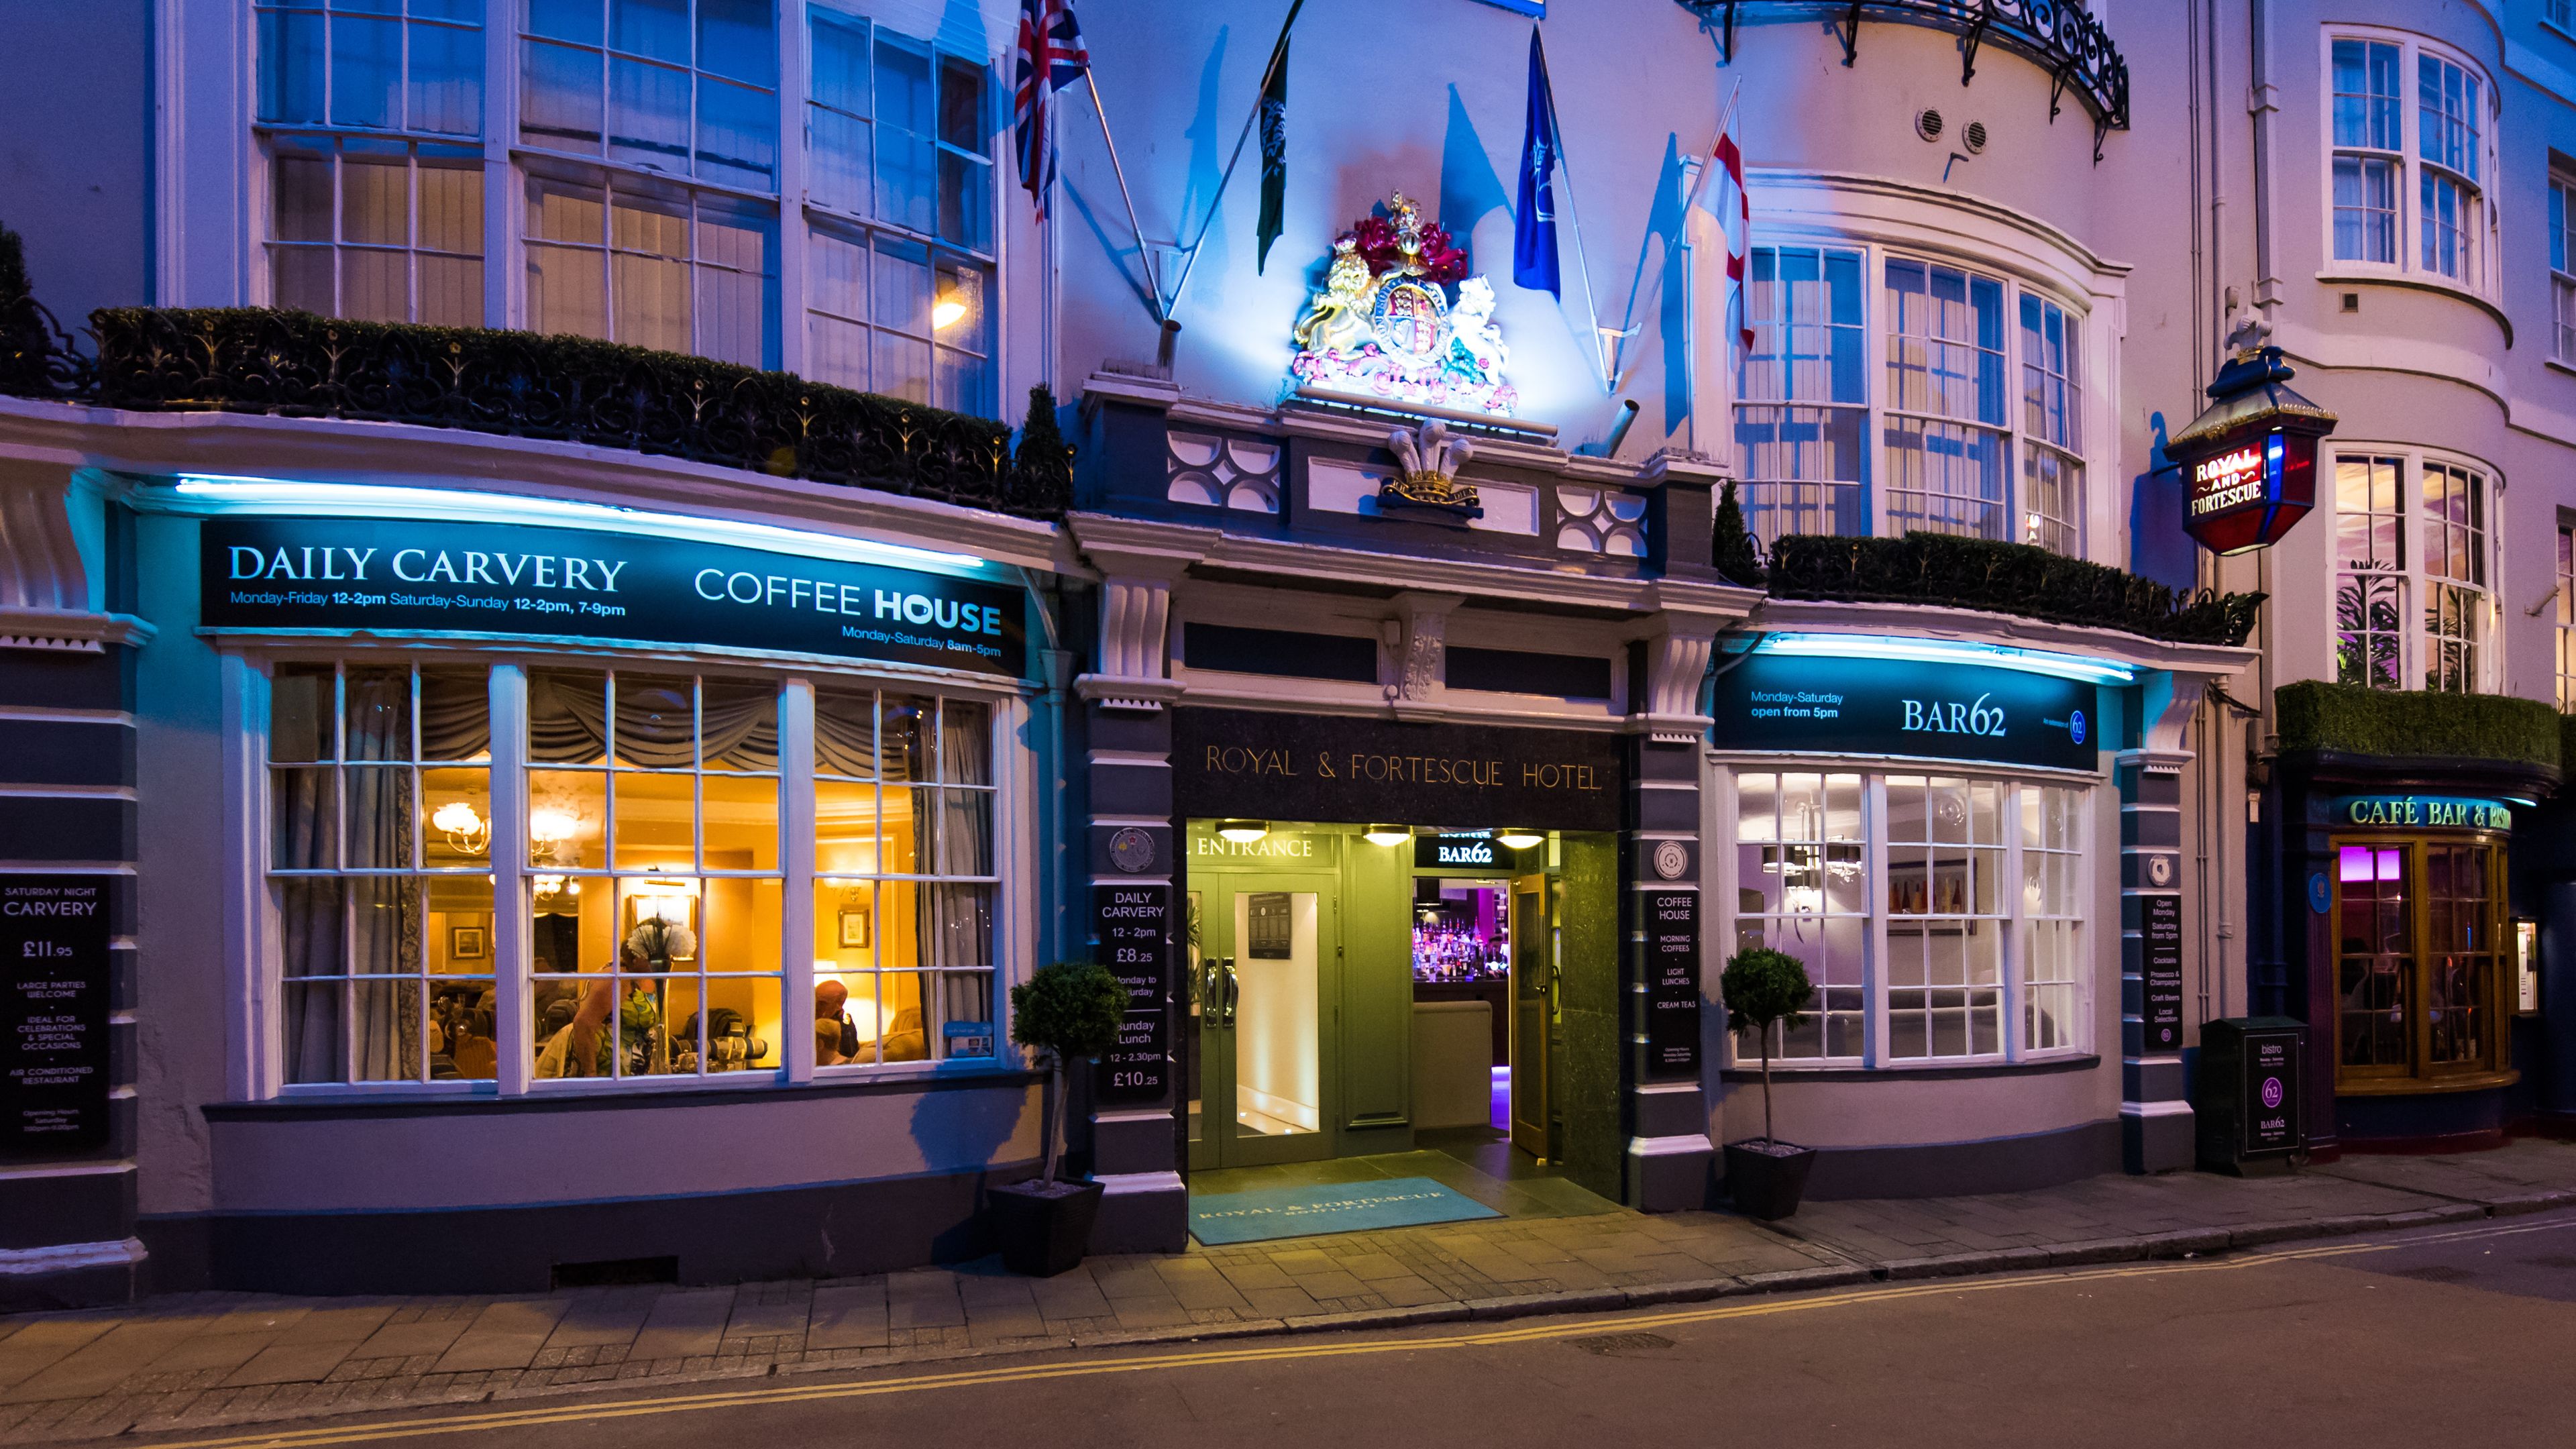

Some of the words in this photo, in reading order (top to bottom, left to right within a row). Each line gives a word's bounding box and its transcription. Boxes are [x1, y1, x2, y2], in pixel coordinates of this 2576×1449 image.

[2196, 449, 2258, 482] ROYAL
[2210, 474, 2240, 491] AND
[2191, 480, 2261, 517] FORTESCUE
[227, 545, 378, 580] DAILY
[392, 549, 627, 592] CARVERY
[231, 591, 328, 607] Monday-Friday
[332, 592, 386, 608] 12-2pm
[390, 593, 509, 611] Saturday-Sunday
[513, 598, 574, 615] 12-2pm,
[578, 601, 626, 616] 7-9pm
[694, 568, 861, 616] COFFEE
[874, 589, 1002, 636] HOUSE
[842, 625, 945, 651] Monday-Saturday
[947, 639, 1002, 658] 8am-5pm
[1752, 690, 1843, 706] Monday-Saturday
[1752, 707, 1781, 719] open
[1783, 706, 1811, 718] from
[1813, 707, 1838, 720] 5pm
[1901, 692, 2007, 737] BAR62
[1208, 745, 1299, 776] ROYAL
[1318, 751, 1336, 778] &
[1351, 754, 1503, 787] FORTESCUE
[1523, 763, 1602, 790] HOTEL
[2349, 796, 2419, 824] CAFÉ
[2428, 802, 2468, 826] BAR
[2474, 804, 2485, 826] &
[1197, 837, 1312, 857] ENTRANCE
[1438, 841, 1493, 863] BAR62
[5, 888, 60, 897] SATURDAY
[64, 888, 97, 897] NIGHT
[1115, 893, 1152, 904] DAILY
[1657, 898, 1692, 907] COFFEE
[2156, 900, 2172, 908] Open
[3, 902, 97, 916] CARVERY
[1102, 907, 1165, 918] CARVERY
[2153, 908, 2176, 917] Monday
[1660, 910, 1690, 920] HOUSE
[2152, 922, 2177, 930] Saturday
[1112, 928, 1124, 937] 12
[1134, 927, 1157, 938] 2pm
[2165, 932, 2178, 940] 5pm
[23, 941, 73, 957] £11.95
[1117, 949, 1152, 963] £8.25
[17, 981, 48, 990] LARGE
[50, 981, 86, 989] PARTIES
[1148, 976, 1157, 984] to
[1662, 977, 1690, 985] LUNCHES
[2150, 979, 2180, 987] Champagne
[27, 989, 76, 999] WELCOME
[1681, 1001, 1696, 1009] TEAS
[28, 1016, 54, 1024] IDEAL
[56, 1015, 76, 1024] FOR
[17, 1024, 86, 1033] CELEBRATIONS
[38, 1032, 76, 1041] SPECIAL
[1119, 1033, 1151, 1044] Lunch
[21, 1041, 82, 1051] OCCASIONS
[2261, 1044, 2282, 1055] bistro
[1110, 1054, 1120, 1063] 12
[1128, 1053, 1161, 1063] 2.30pm
[28, 1066, 94, 1076] CONDITIONED
[22, 1075, 80, 1085] RESTAURANT
[1114, 1072, 1159, 1087] £10.25
[2265, 1081, 2278, 1099] 62
[2261, 1116, 2285, 1129] BAR62
[1198, 1207, 1282, 1219] ROYAL
[1311, 1191, 1444, 1210] FORTESCUE
